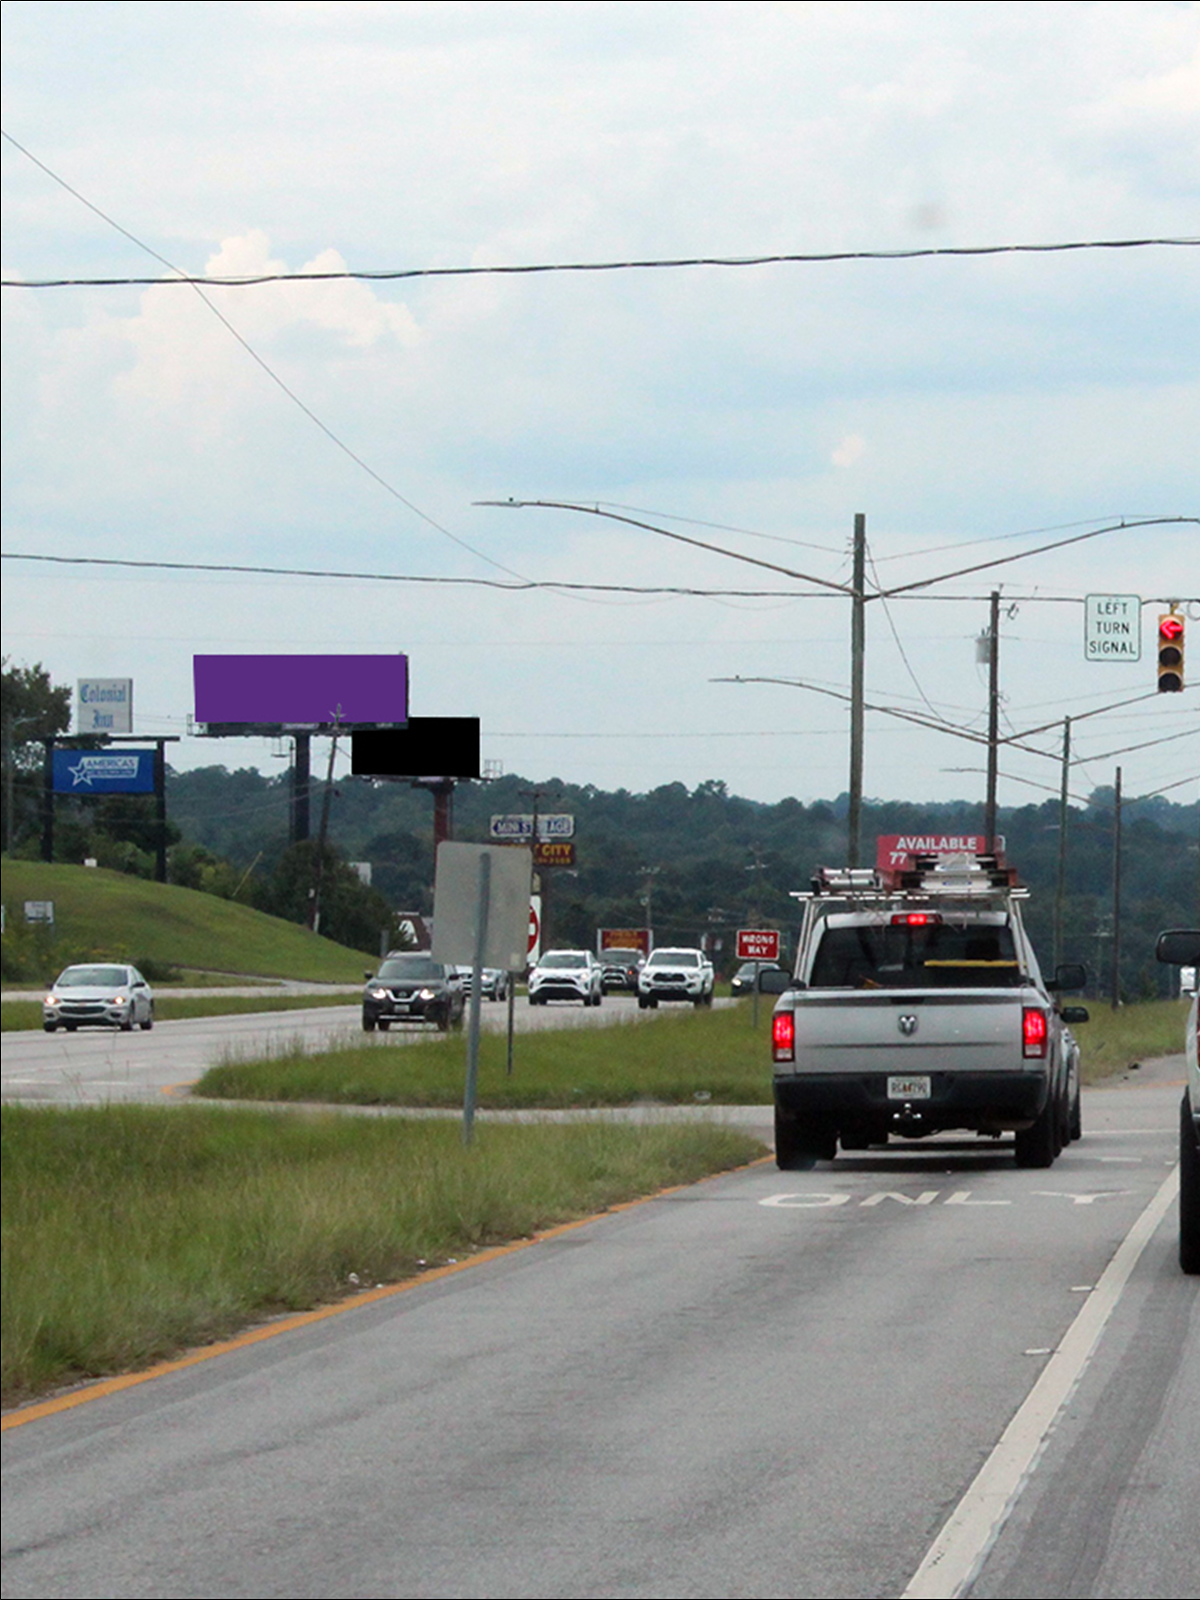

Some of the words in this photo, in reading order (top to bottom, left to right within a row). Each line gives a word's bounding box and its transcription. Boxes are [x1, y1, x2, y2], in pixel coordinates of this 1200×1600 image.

[1097, 602, 1127, 615] LEFT
[1096, 621, 1130, 634] TURN
[1089, 640, 1136, 654] SIGNAL
[80, 684, 126, 703] Colonial
[896, 836, 977, 850] AVAILABLE
[541, 844, 572, 856] CITY
[741, 935, 774, 945] WRONG
[747, 946, 768, 955] WAY
[758, 1191, 1140, 1208] ONLY
